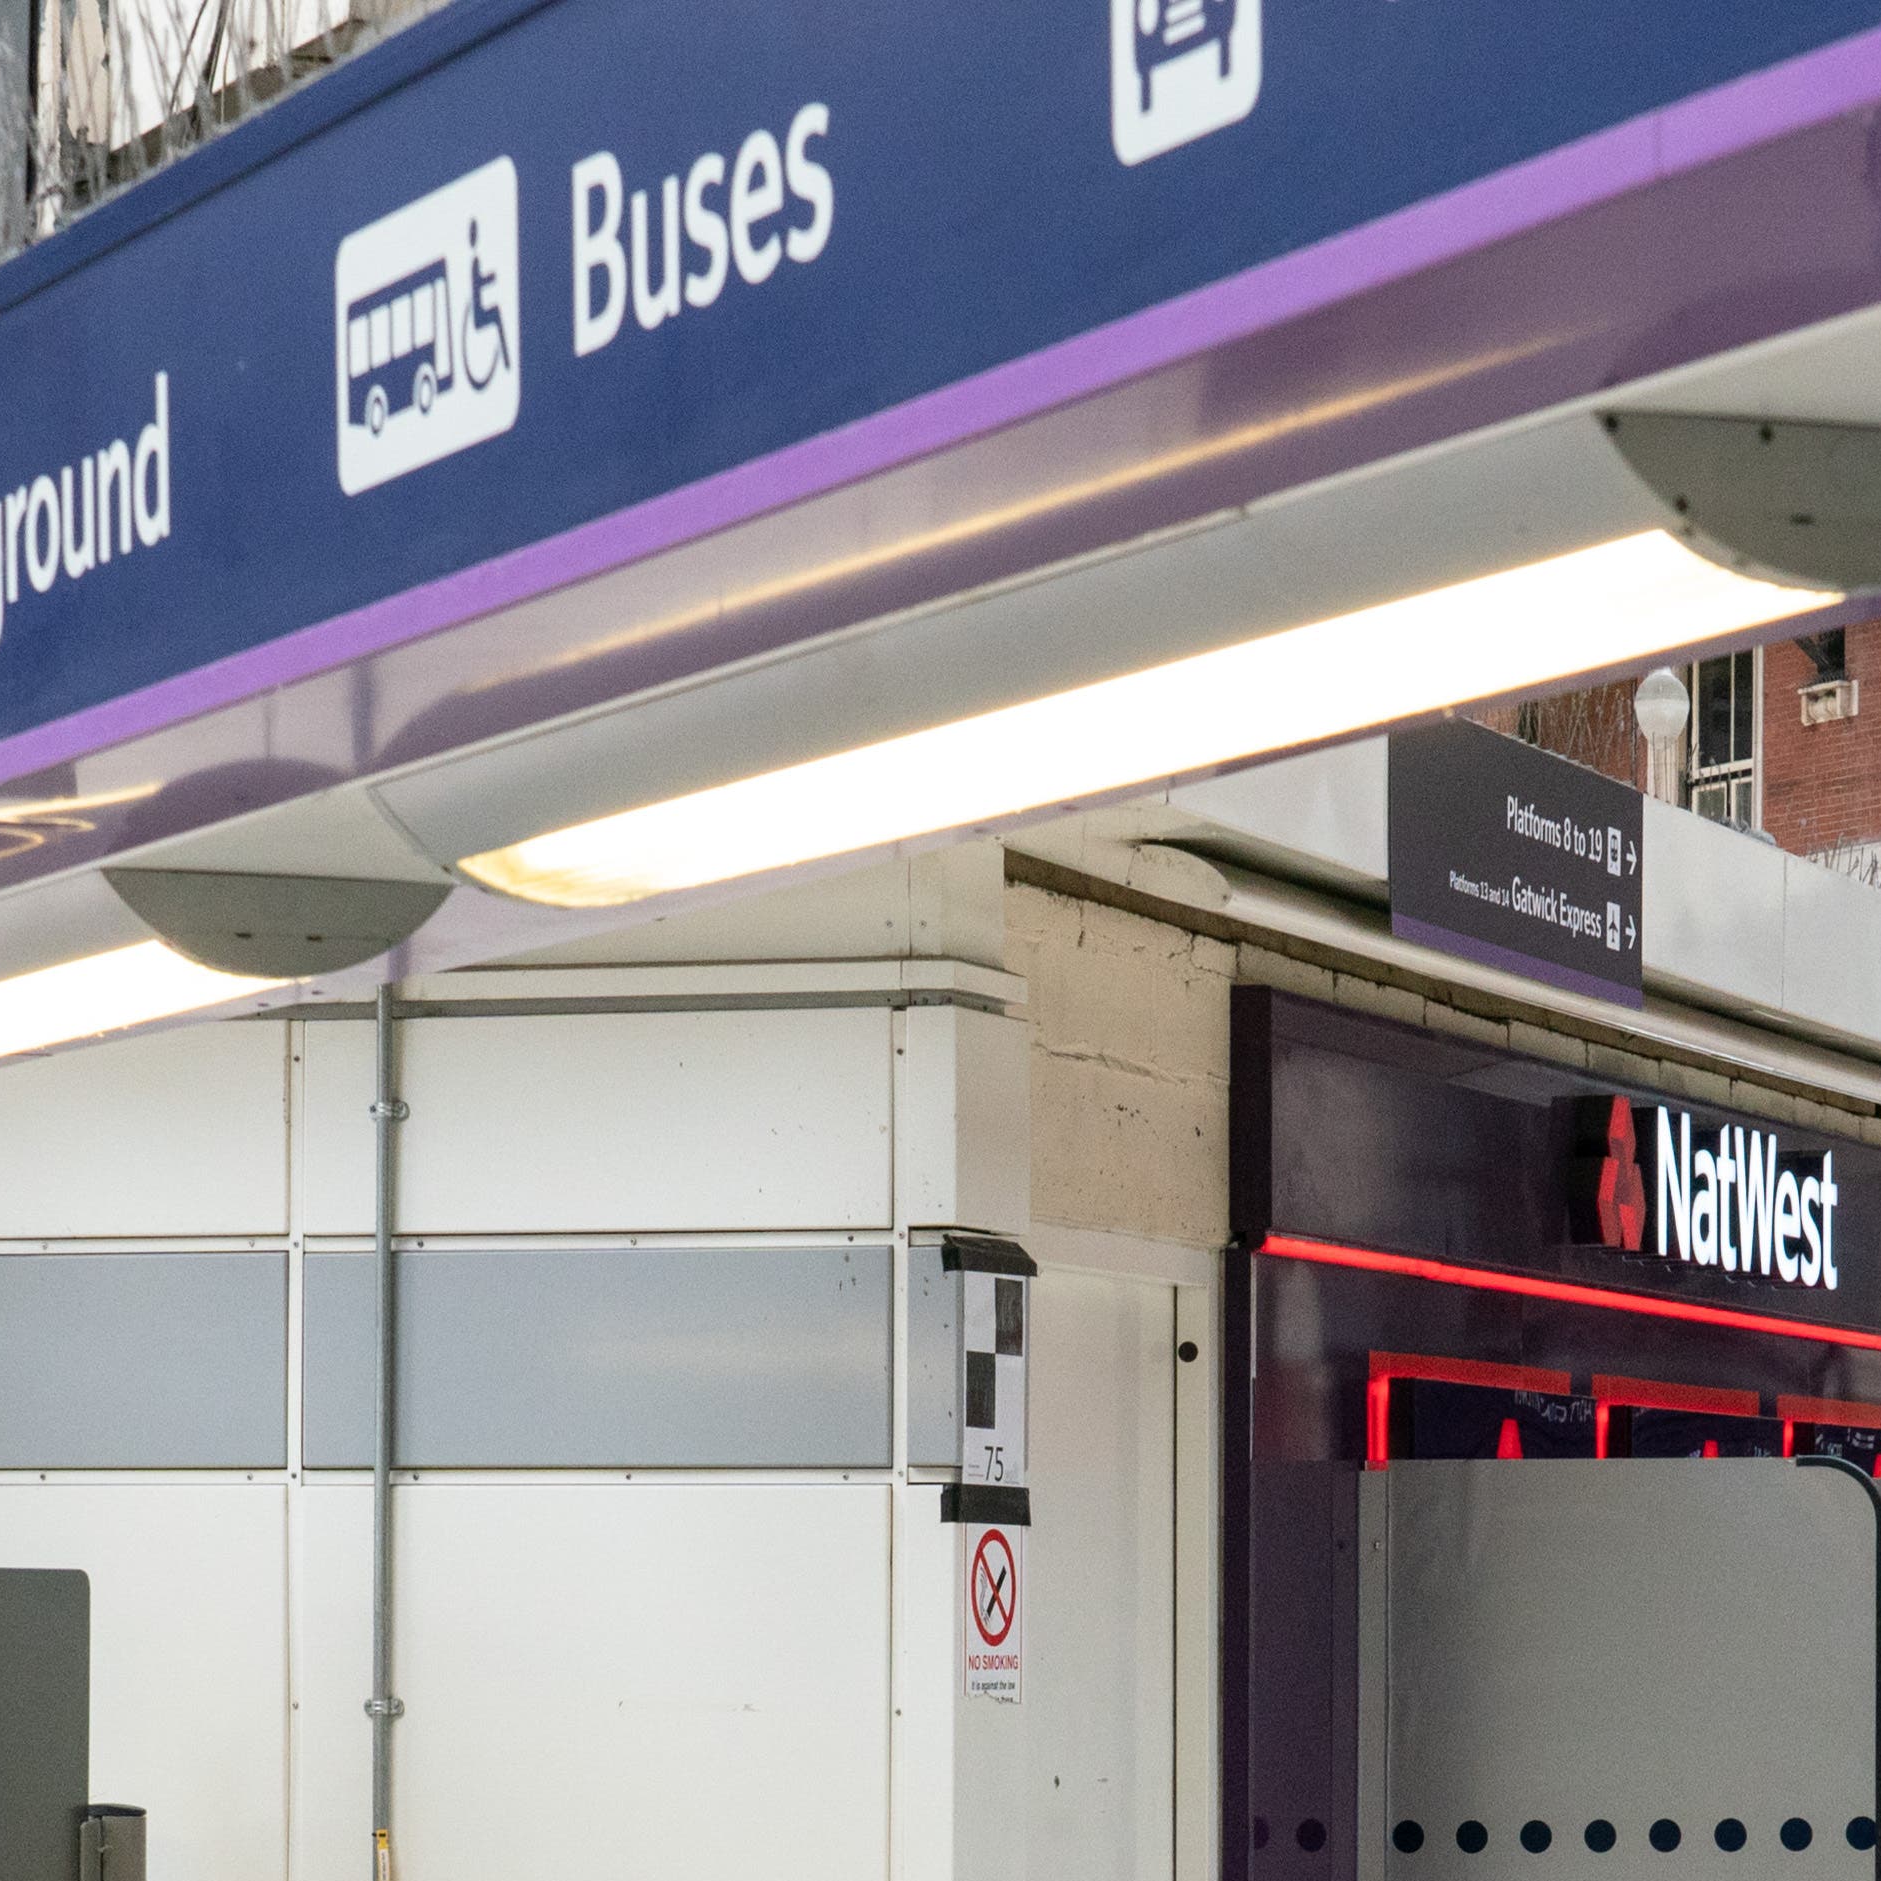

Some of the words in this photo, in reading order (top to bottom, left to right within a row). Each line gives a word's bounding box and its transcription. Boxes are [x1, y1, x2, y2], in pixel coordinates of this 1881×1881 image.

[572, 103, 833, 356] Buses
[1506, 795, 1561, 849] Platforms
[1564, 817, 1571, 851] 8
[1573, 825, 1586, 857] to
[1588, 827, 1603, 863] 19
[1449, 870, 1479, 898] Platforms
[1480, 881, 1489, 899] 13
[1489, 887, 1501, 904] and
[1501, 888, 1510, 907] 14
[1511, 876, 1557, 924] Gatwick
[1560, 892, 1602, 938] Express
[1657, 1105, 1838, 1290] NatWest
[984, 1445, 1004, 1482] 75
[969, 1655, 980, 1670] NO
[983, 1655, 1018, 1670] SMOKING
